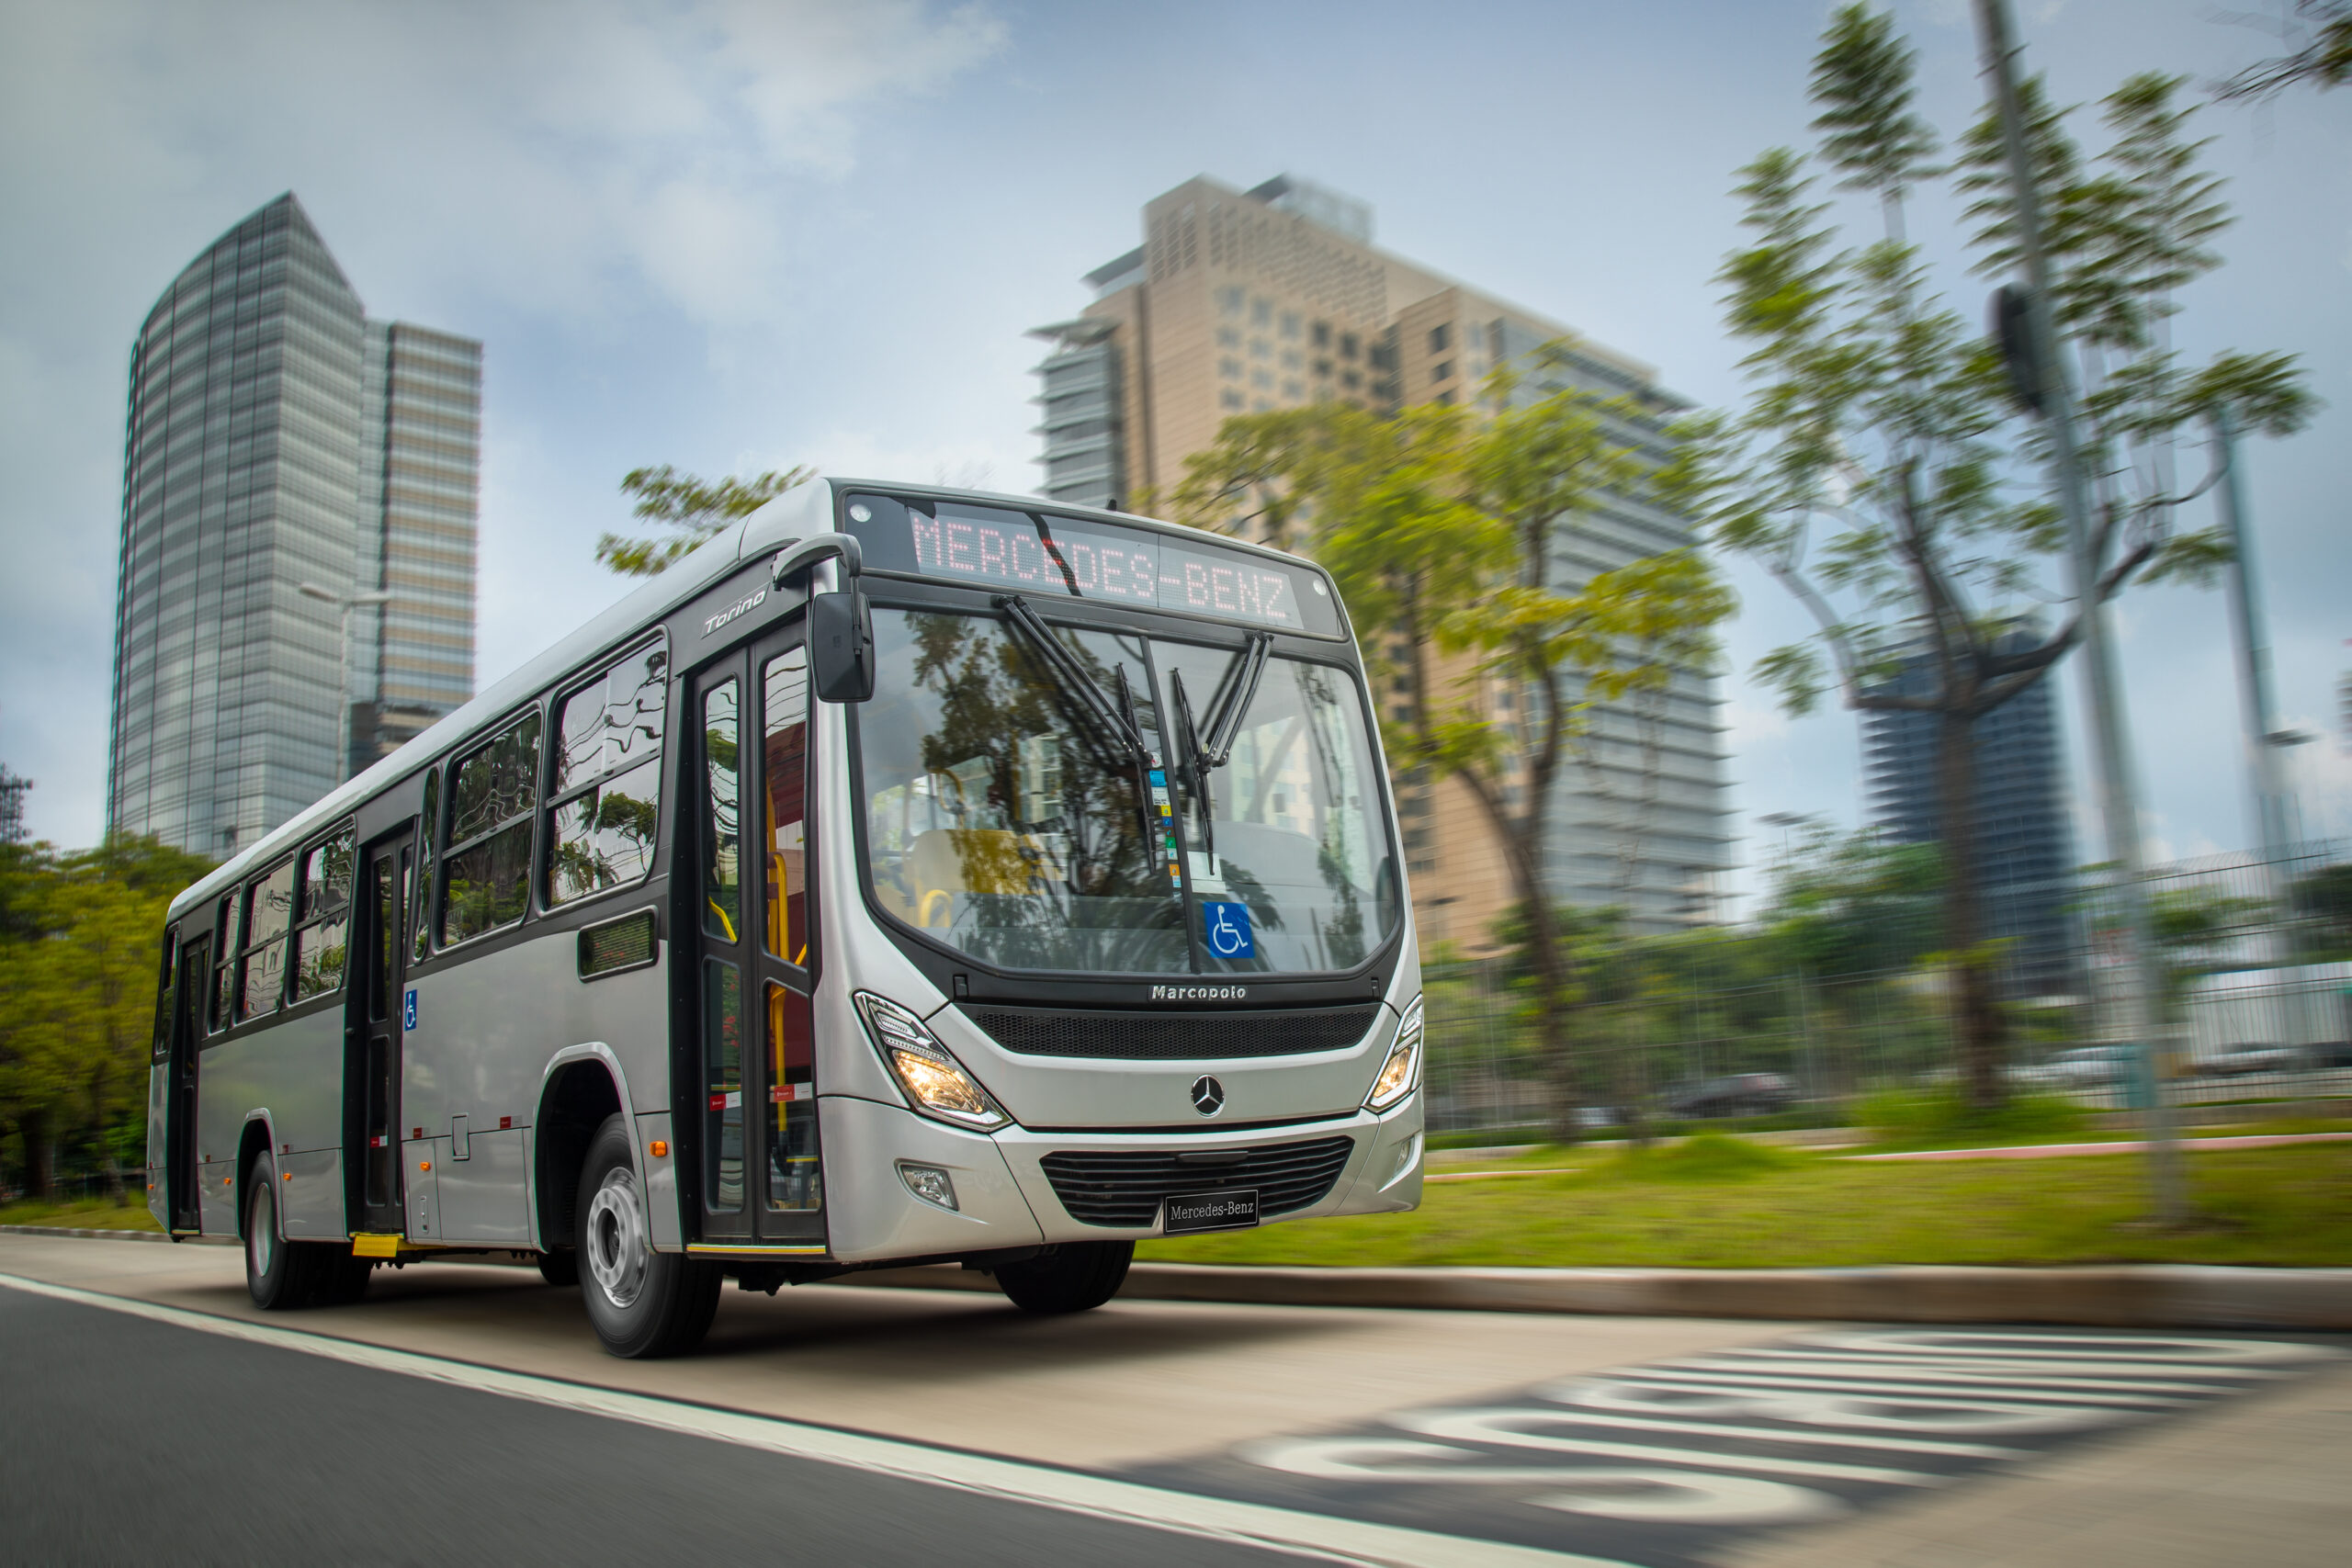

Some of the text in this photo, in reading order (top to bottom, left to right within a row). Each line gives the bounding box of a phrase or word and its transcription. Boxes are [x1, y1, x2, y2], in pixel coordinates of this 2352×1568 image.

[912, 517, 1285, 618] MERCEDES-BENZ
[706, 591, 766, 634] Torino
[1151, 985, 1247, 1000] Marcopolo
[1170, 1201, 1254, 1220] Mercedes-Benz
